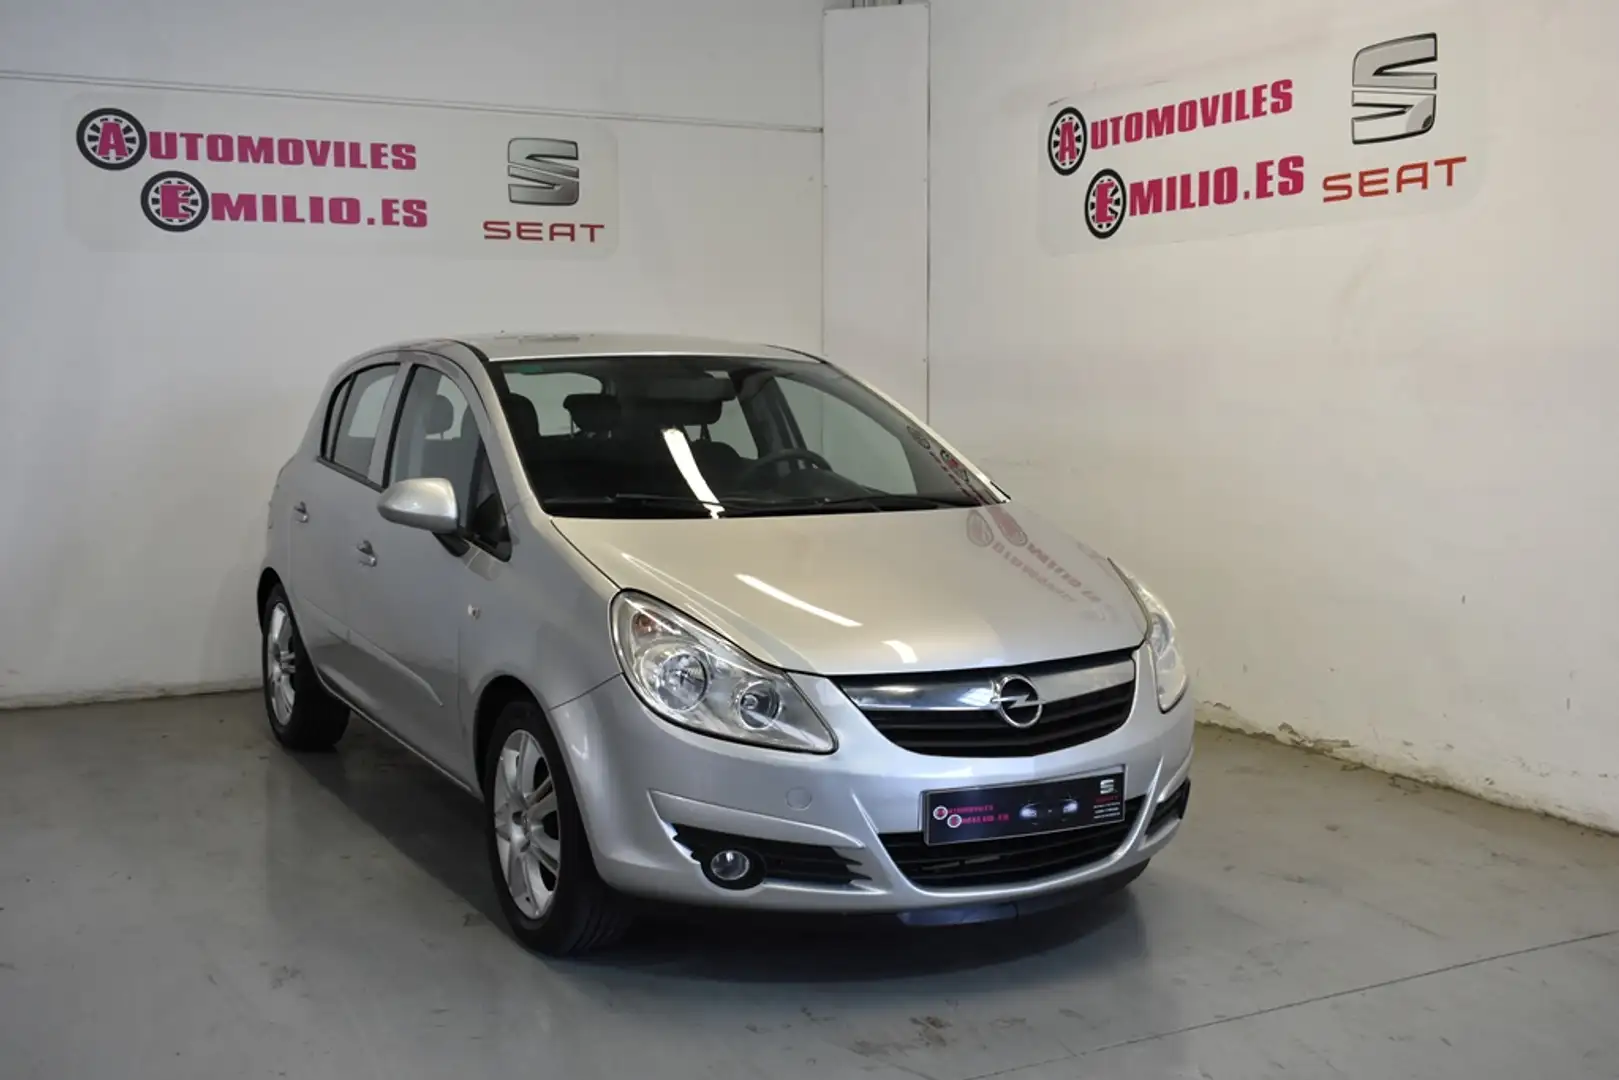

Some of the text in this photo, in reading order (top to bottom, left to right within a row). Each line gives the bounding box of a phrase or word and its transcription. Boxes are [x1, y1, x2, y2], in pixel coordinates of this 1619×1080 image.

[1059, 79, 1293, 162] AUTOMOVILES
[97, 121, 417, 170] AUTOMOVILES
[1096, 155, 1304, 223] EMILIO.ES
[1322, 156, 1466, 203] SEAT
[159, 184, 428, 228] EMILIO.ES
[483, 220, 604, 243] SEAT
